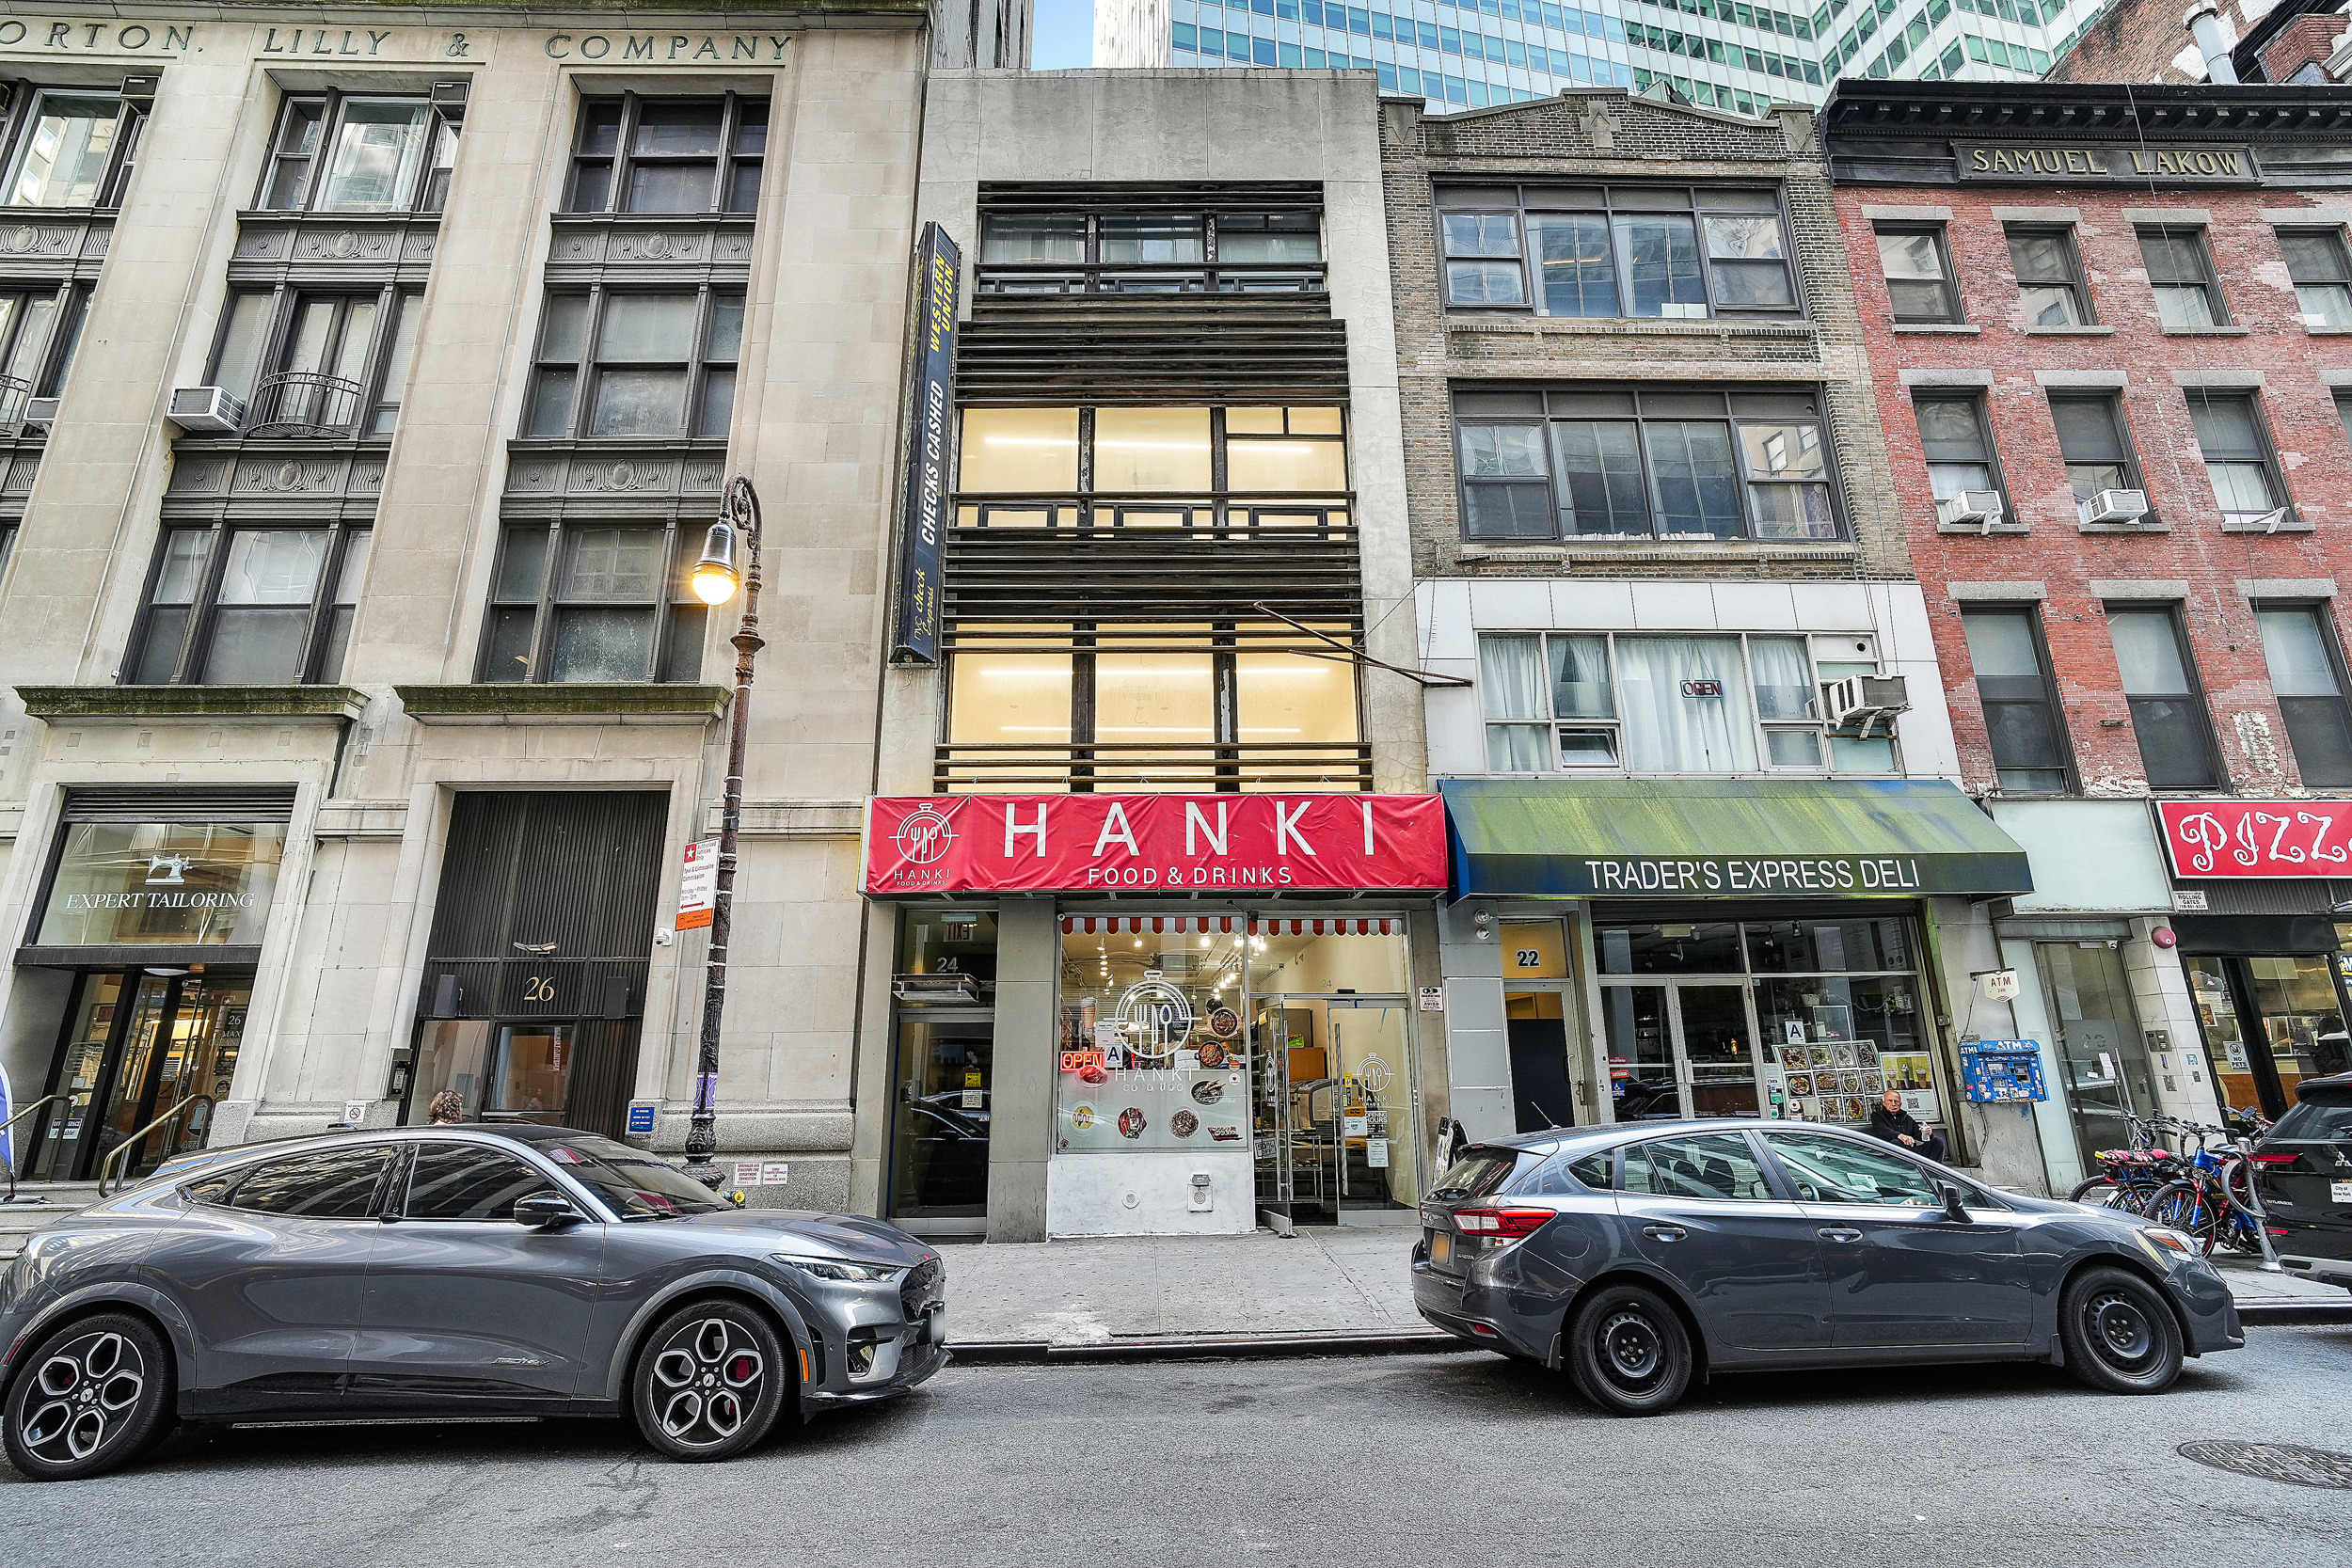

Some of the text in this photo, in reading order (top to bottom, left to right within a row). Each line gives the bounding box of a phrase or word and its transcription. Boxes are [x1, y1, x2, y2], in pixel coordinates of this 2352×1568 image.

[263, 28, 390, 55] LILLY
[446, 33, 469, 57] &
[544, 35, 792, 60] COMPANY
[1972, 150, 2240, 175] SAMUEL LAKOW
[930, 256, 946, 353] WESTERN
[941, 264, 954, 332] UNION
[921, 380, 945, 546] CHECKS CASHED
[914, 566, 927, 613] check
[922, 587, 934, 636] Express
[1683, 682, 1723, 695] OPEN
[1004, 801, 1375, 857] HANKI
[2179, 810, 2352, 872] PIZZ
[894, 868, 950, 879] HANKI
[1088, 866, 1292, 885] FOOD & DRINKS
[1584, 859, 1921, 890] TRADER'S EXPRESS DELI
[66, 892, 255, 909] EXPERT TAILORING
[936, 957, 958, 973] 24
[1517, 950, 1540, 967] 22
[523, 976, 555, 1002] 26
[1321, 979, 1332, 988] 24
[1991, 976, 2011, 987] ATM
[228, 1015, 242, 1025] 26
[1789, 1023, 1803, 1037] A
[1106, 1046, 1120, 1061] A
[1996, 1040, 2023, 1051] ATM
[1063, 1053, 1103, 1069] OPEN
[1115, 1068, 1194, 1082] HANKI
